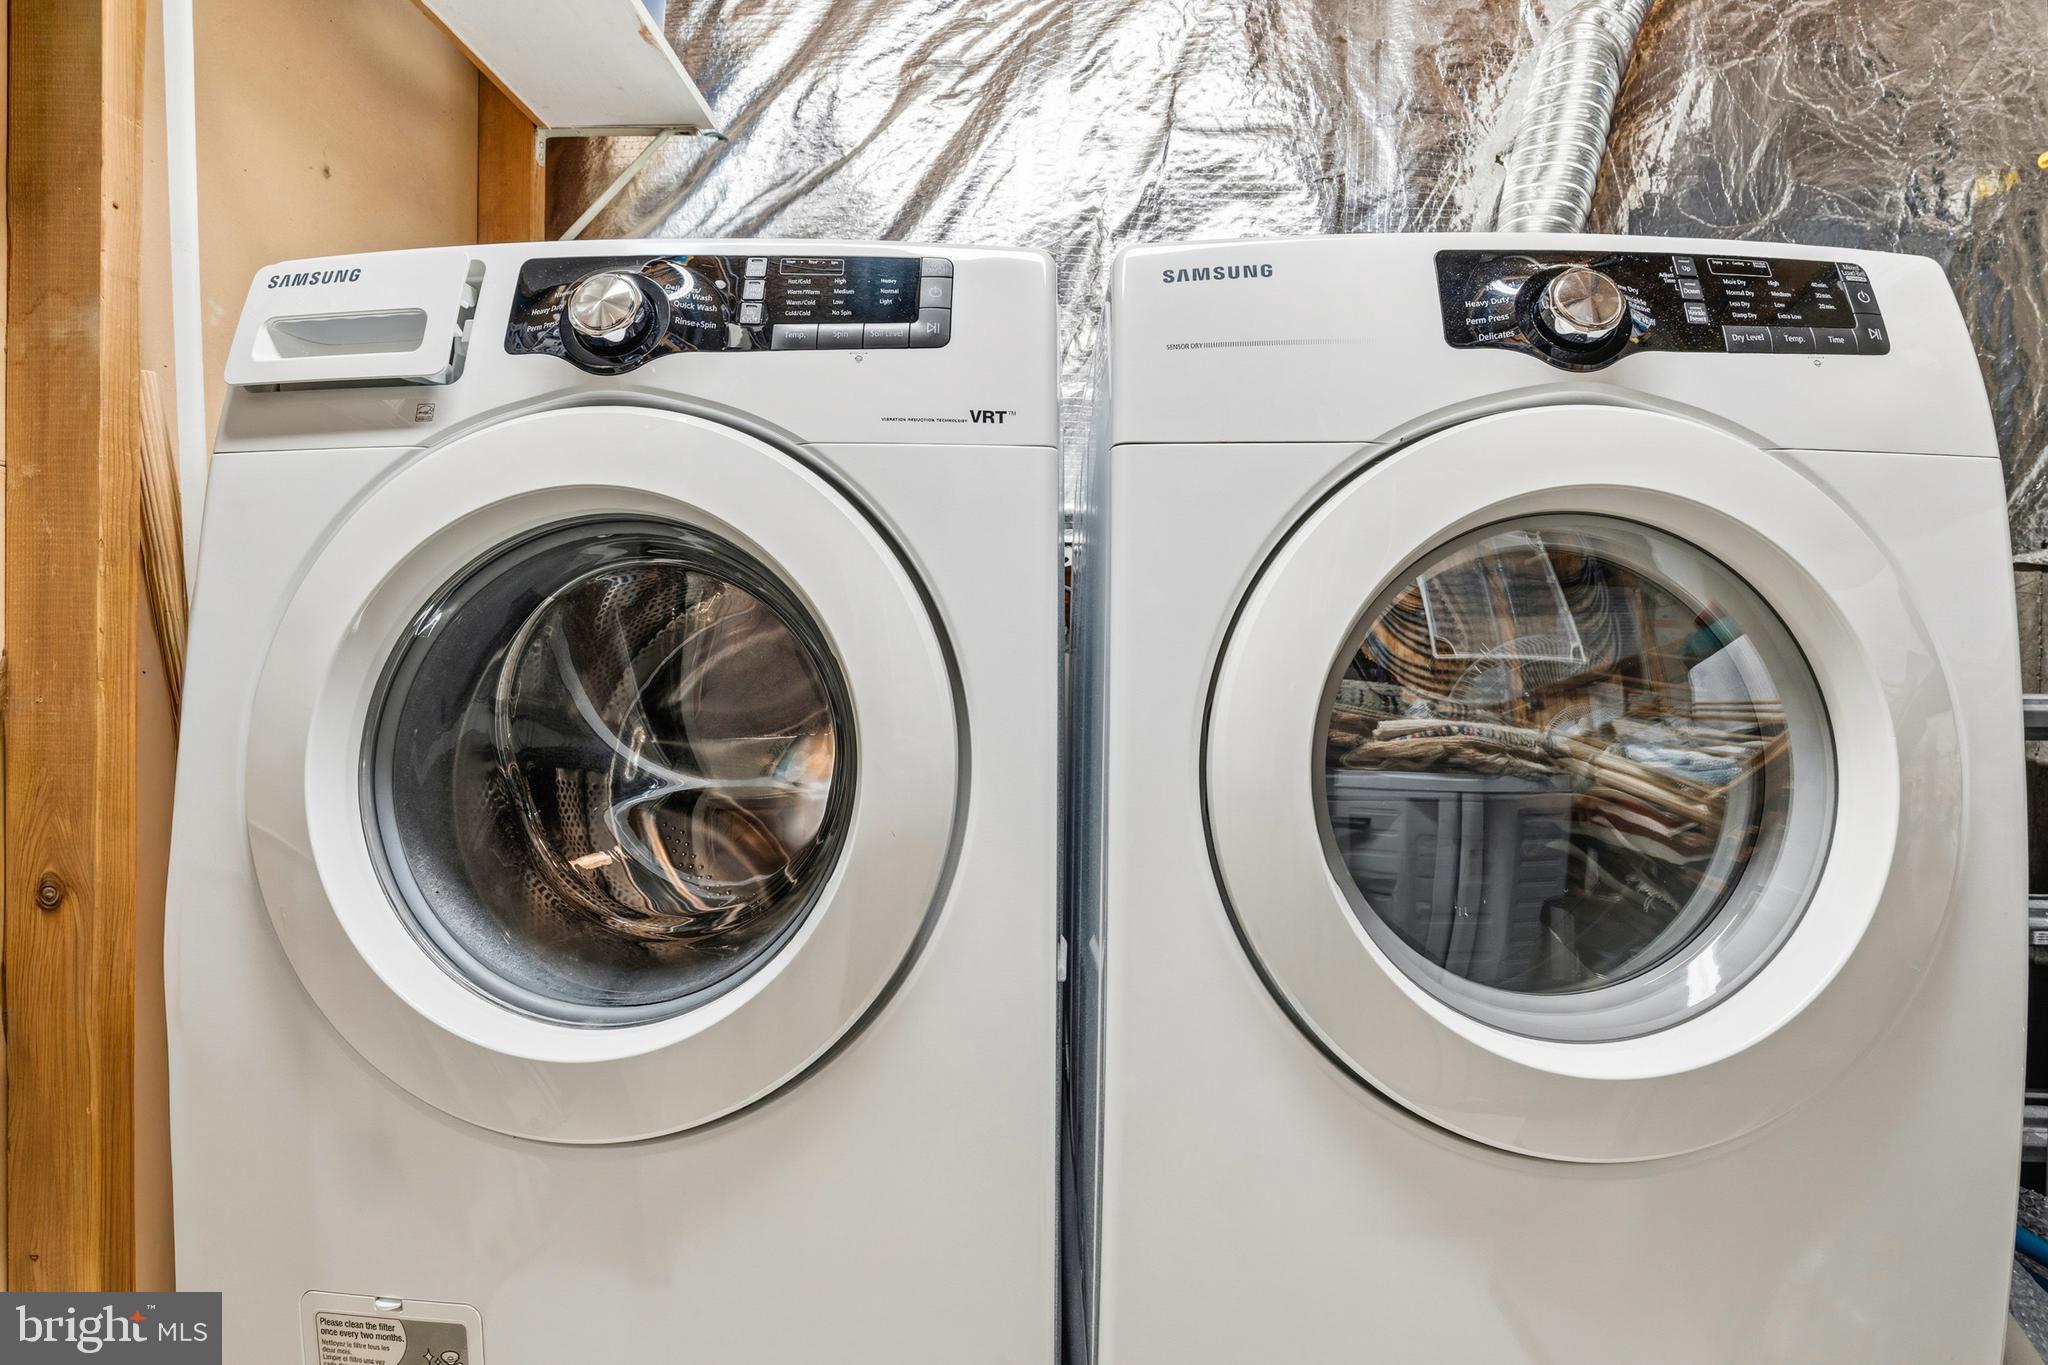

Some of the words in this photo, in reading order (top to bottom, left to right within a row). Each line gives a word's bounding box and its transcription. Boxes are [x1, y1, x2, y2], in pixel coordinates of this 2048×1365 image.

[1681, 264, 1692, 273] Up
[267, 268, 361, 289] SAMSUNG
[1162, 264, 1273, 284] SAMSUNG
[834, 278, 847, 286] High
[880, 277, 897, 286] Heavy
[1736, 279, 1747, 287] Dry
[1767, 280, 1780, 288] High
[880, 287, 900, 295] Normal
[1683, 287, 1701, 295] Down
[673, 300, 695, 310] Quick
[697, 303, 718, 312] Wash
[785, 299, 816, 307] Warm/Cold
[879, 298, 893, 307] Light
[1465, 300, 1489, 308] Heavy
[1490, 296, 1511, 305] Duty
[1740, 301, 1752, 310] Dry
[531, 307, 551, 316] Heavy
[784, 309, 811, 318] Cold/Cold
[841, 310, 853, 318] Spin
[1731, 311, 1748, 319] Damp
[1747, 312, 1759, 320] Dry
[1465, 317, 1487, 326] Perm
[1488, 313, 1510, 323] Press
[527, 324, 543, 332] Perm
[785, 330, 807, 341] Temp.
[832, 329, 849, 340] Spin
[1478, 330, 1516, 342] Delicates
[1731, 333, 1746, 344] Dry
[1745, 333, 1765, 342] Level
[1783, 334, 1806, 345] Temp.
[1827, 335, 1846, 345] Time
[1166, 343, 1190, 351] SENSOR
[1190, 342, 1204, 350] DRY
[969, 409, 1008, 424] VRT
[319, 1316, 344, 1328] Please
[344, 1319, 364, 1330] clean
[365, 1321, 378, 1331] the
[378, 1322, 396, 1333] filter
[320, 1328, 338, 1337] once
[339, 1330, 360, 1340] every
[360, 1331, 375, 1340] two
[375, 1333, 405, 1343] months.
